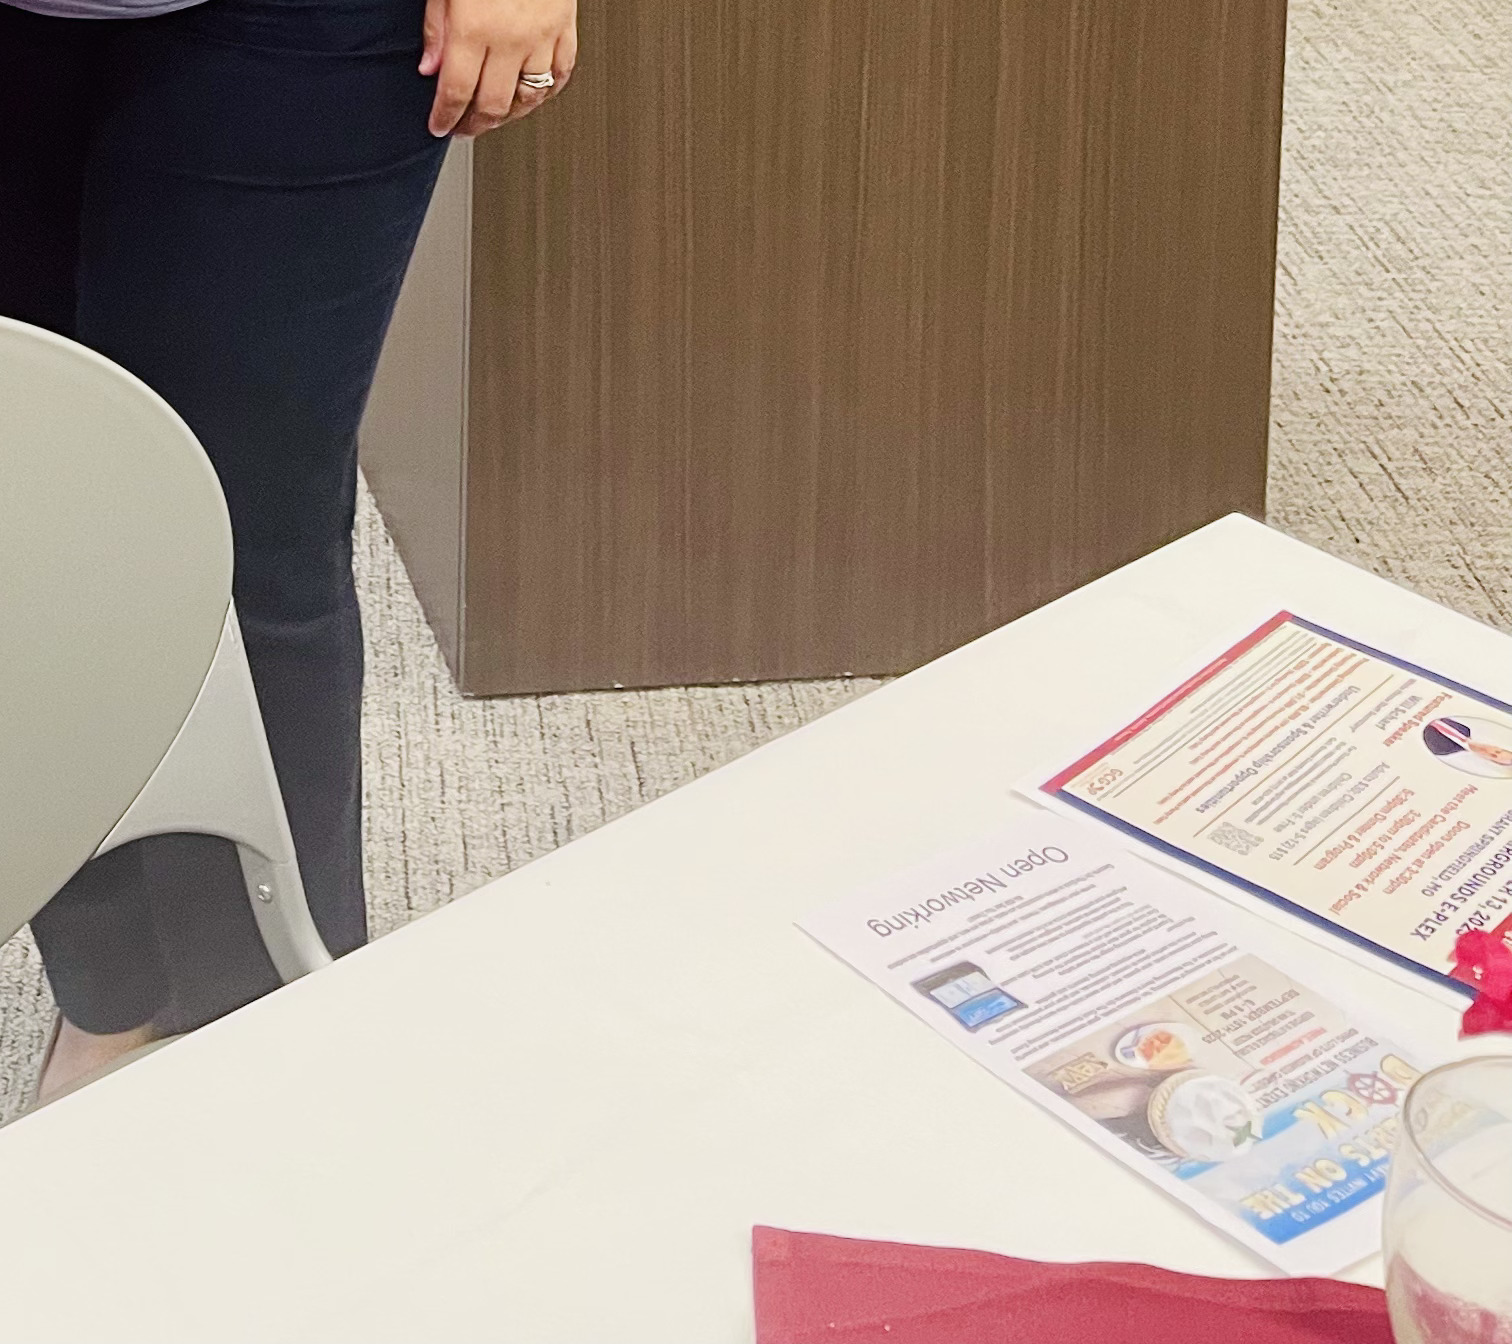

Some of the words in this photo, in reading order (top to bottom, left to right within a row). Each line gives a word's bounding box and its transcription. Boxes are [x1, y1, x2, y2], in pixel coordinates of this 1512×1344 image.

[999, 846, 1069, 878] Open
[866, 872, 1008, 939] Networking
[1421, 880, 1442, 898] MO
[1477, 895, 1509, 911] 13,
[1410, 901, 1459, 941] E-PLEX
[1294, 1159, 1347, 1193] ON
[1239, 1184, 1306, 1220] THE
